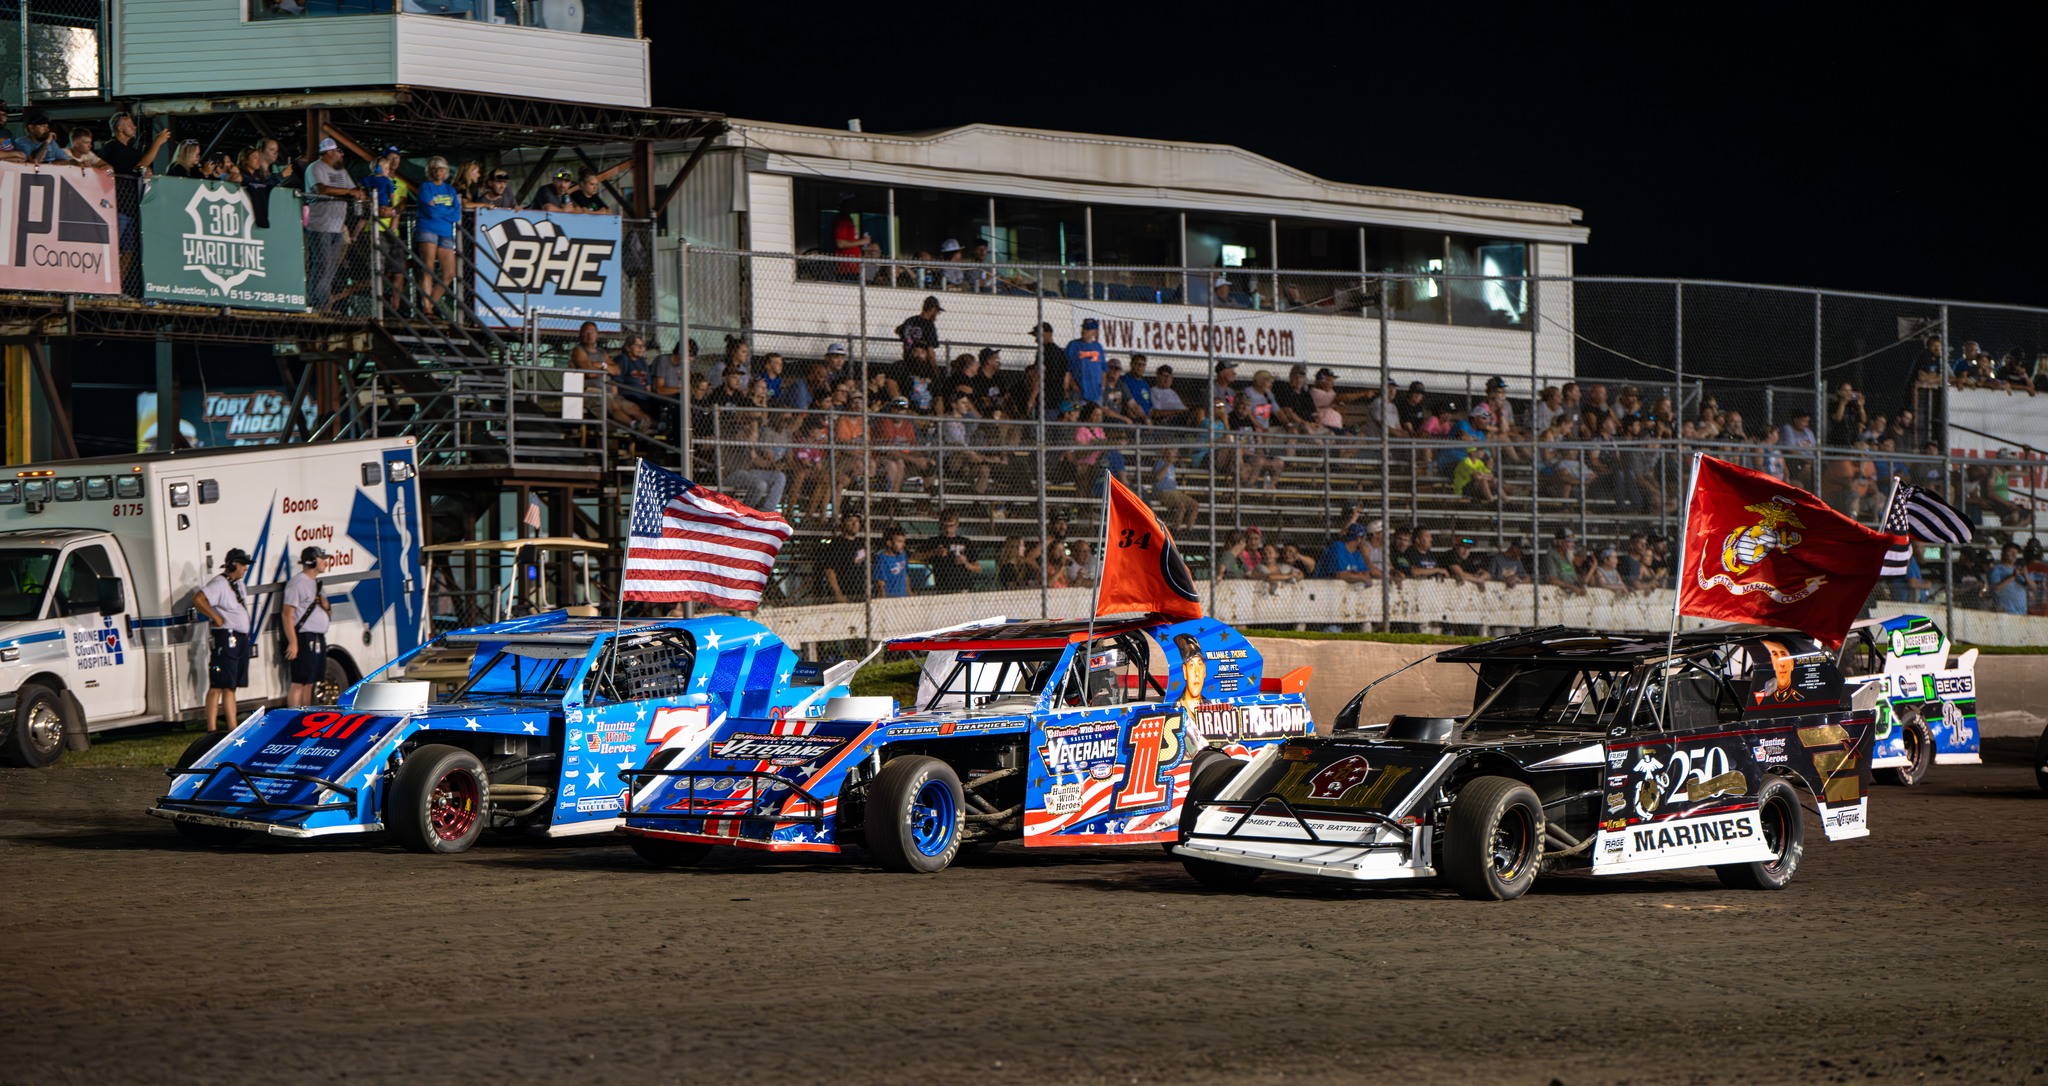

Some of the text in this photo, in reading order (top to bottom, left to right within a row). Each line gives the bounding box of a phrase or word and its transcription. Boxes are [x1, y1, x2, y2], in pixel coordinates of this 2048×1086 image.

[33, 244, 102, 275] Canopy
[183, 239, 266, 271] YARD LINE
[495, 239, 615, 295] BHE
[146, 282, 306, 305] Grand Junction, IA 515-738-2189
[477, 303, 621, 320] www.BHarrisEnt.com
[1096, 313, 1295, 357] ww.raceboone.com
[206, 392, 283, 417] TOBY K'S
[112, 503, 144, 517] 8175
[282, 496, 319, 514] Boone
[294, 524, 334, 543] County
[1118, 528, 1152, 550] 34
[323, 548, 354, 573] pital
[1713, 575, 1735, 591] STATES
[1742, 582, 1776, 596] MARINE
[1780, 589, 1810, 603] CORPS
[73, 630, 99, 644] BOONE
[75, 643, 105, 657] COUNTY
[77, 655, 113, 670] HOSPITAL
[1936, 676, 1973, 694] BECK'S
[596, 721, 636, 733] Hunting
[1197, 710, 1237, 737] IRAQI
[1242, 706, 1303, 736] FREDOM
[646, 704, 711, 765] 7
[888, 727, 939, 736] SYBESMA
[1053, 728, 1079, 738] Hunting
[1094, 723, 1116, 732] Heroes
[261, 743, 341, 758] 2977 victims
[600, 743, 637, 755] Heroes
[717, 739, 832, 757] VETERANS
[1048, 737, 1116, 769] VETERANS
[1667, 746, 1730, 803] 250
[577, 803, 606, 811] SALUTE
[1056, 801, 1081, 811] Heroes
[1244, 818, 1276, 826] OMBAT
[1277, 821, 1325, 830] ENGIEER
[1326, 823, 1378, 833] BATTALION
[1604, 837, 1625, 849] RAGE
[1633, 817, 1754, 853] MARINES
